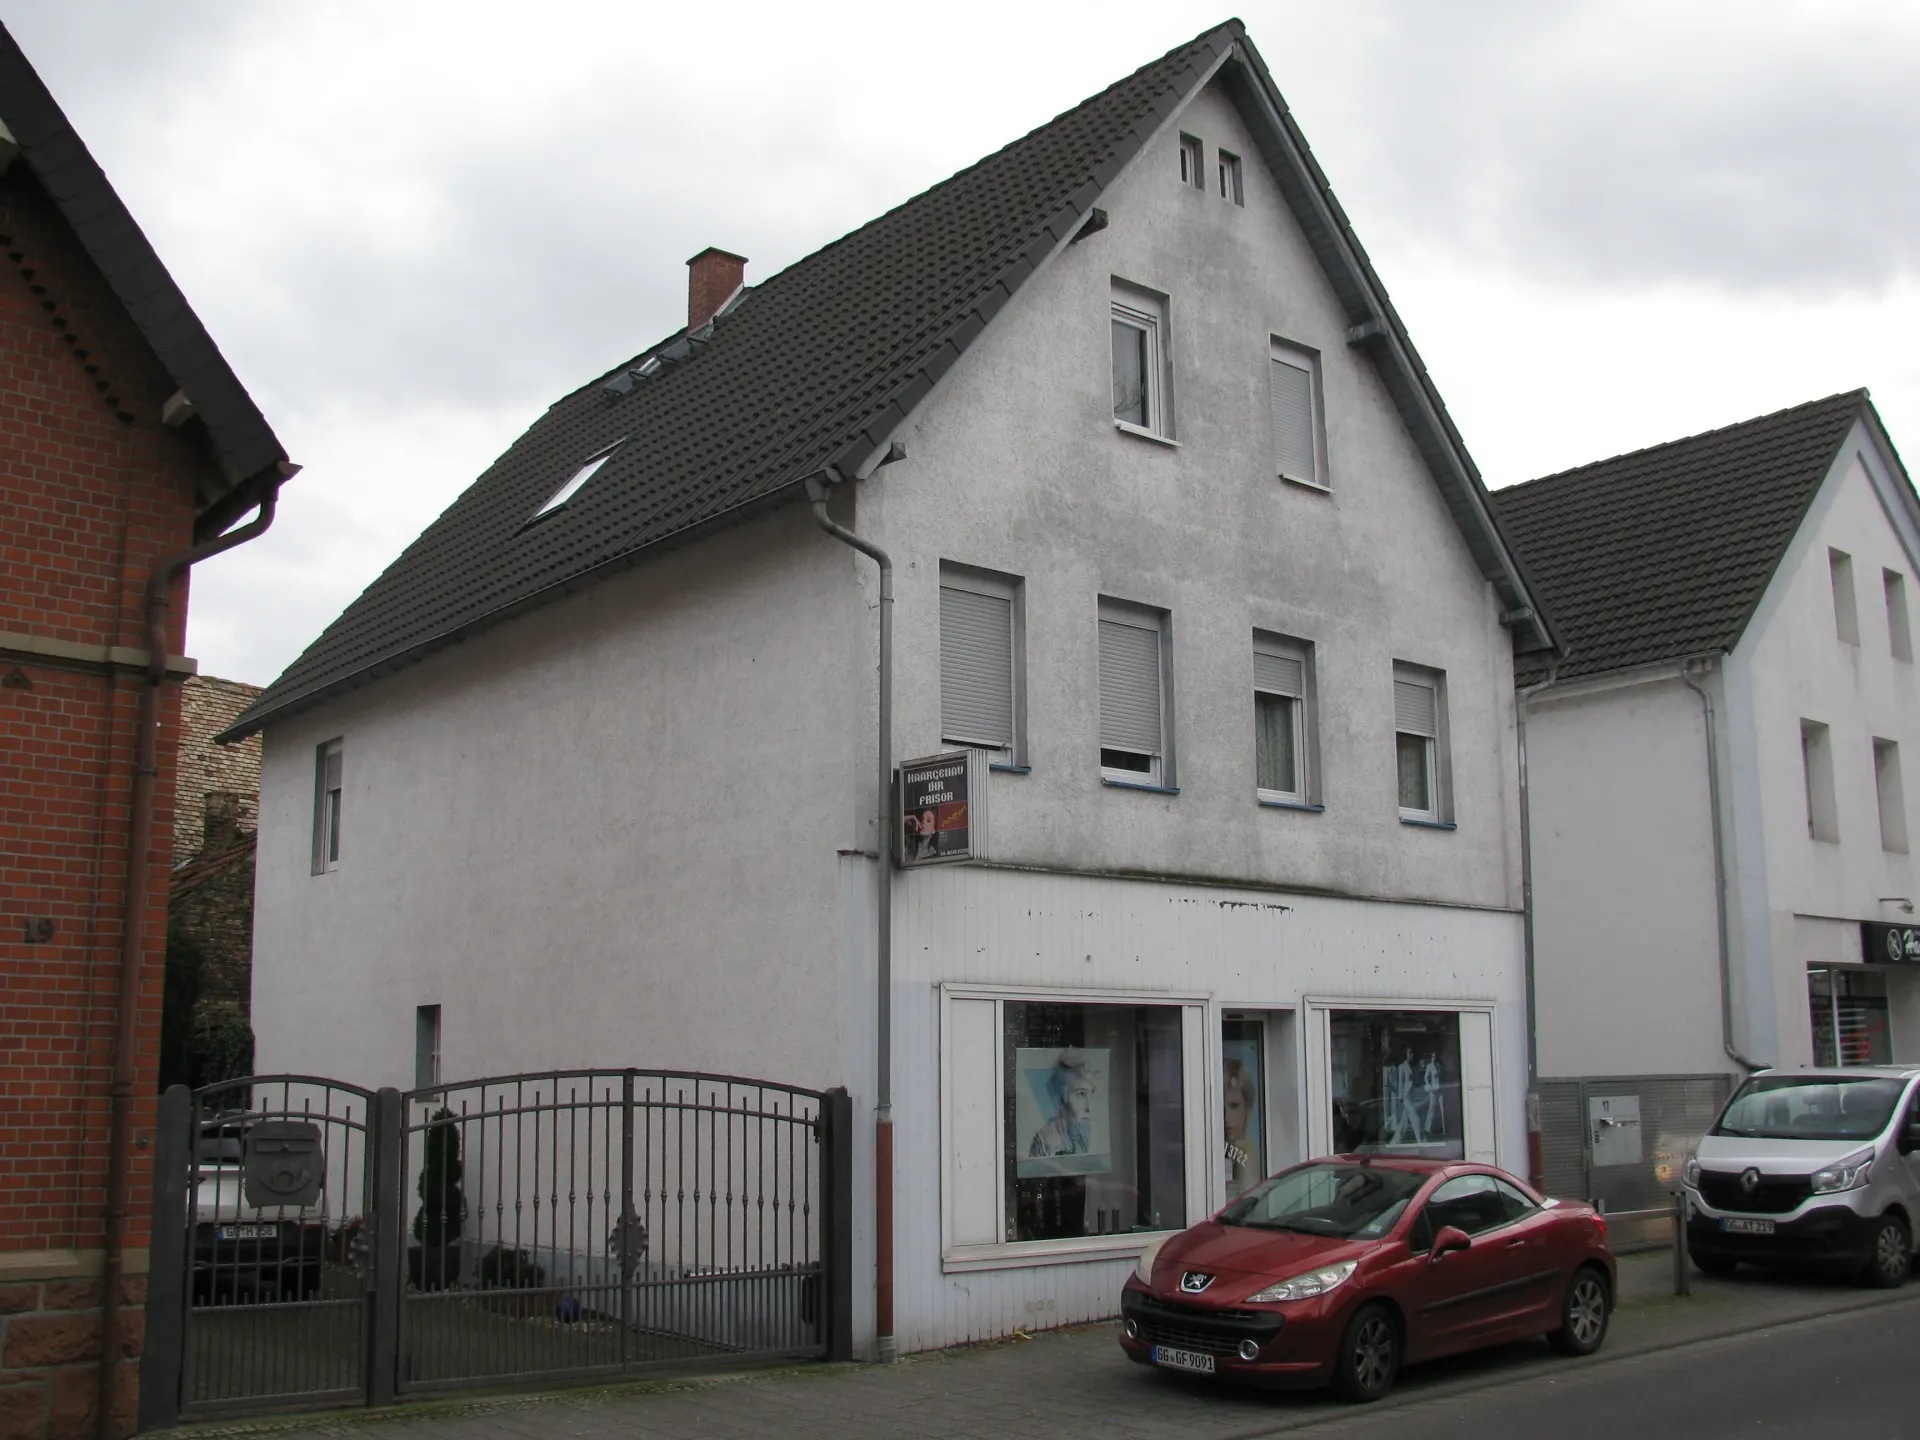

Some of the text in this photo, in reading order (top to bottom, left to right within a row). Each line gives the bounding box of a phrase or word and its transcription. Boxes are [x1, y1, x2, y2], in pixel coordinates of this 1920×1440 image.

[907, 765, 964, 784] HAARGENAU
[928, 780, 944, 792] IHR
[1157, 1347, 1213, 1370] GG GF 9091
